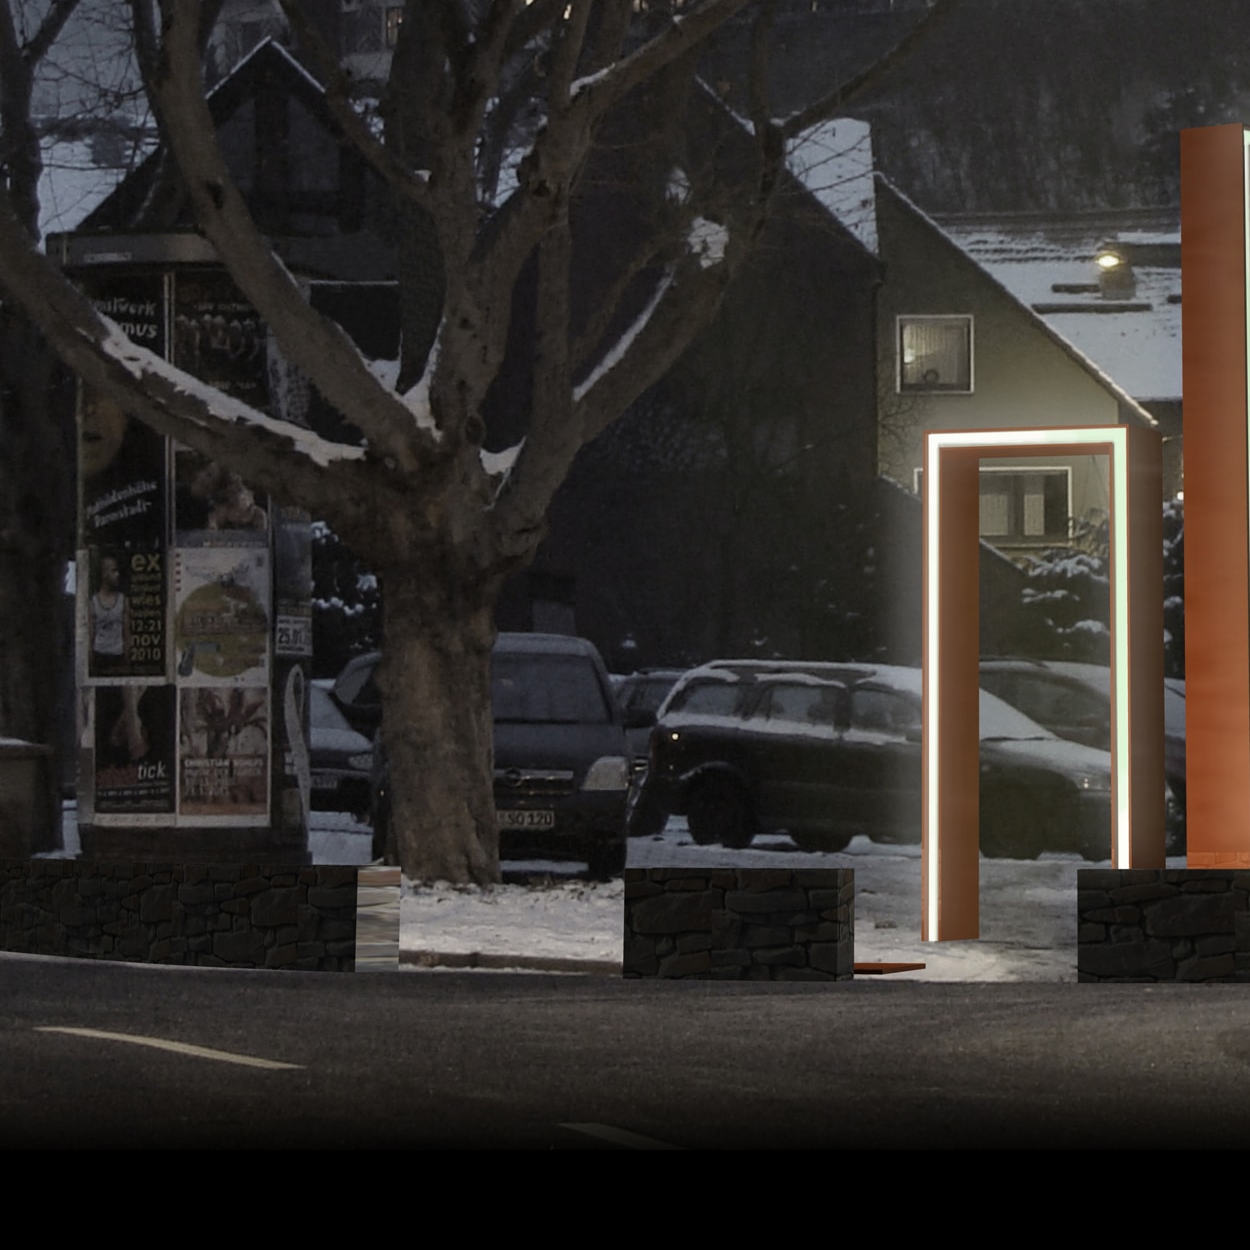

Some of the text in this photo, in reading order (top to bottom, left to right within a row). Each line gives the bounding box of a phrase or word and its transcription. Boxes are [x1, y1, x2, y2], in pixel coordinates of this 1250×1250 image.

[131, 554, 160, 572] ex
[131, 634, 161, 647] nov
[131, 648, 161, 661] 2010
